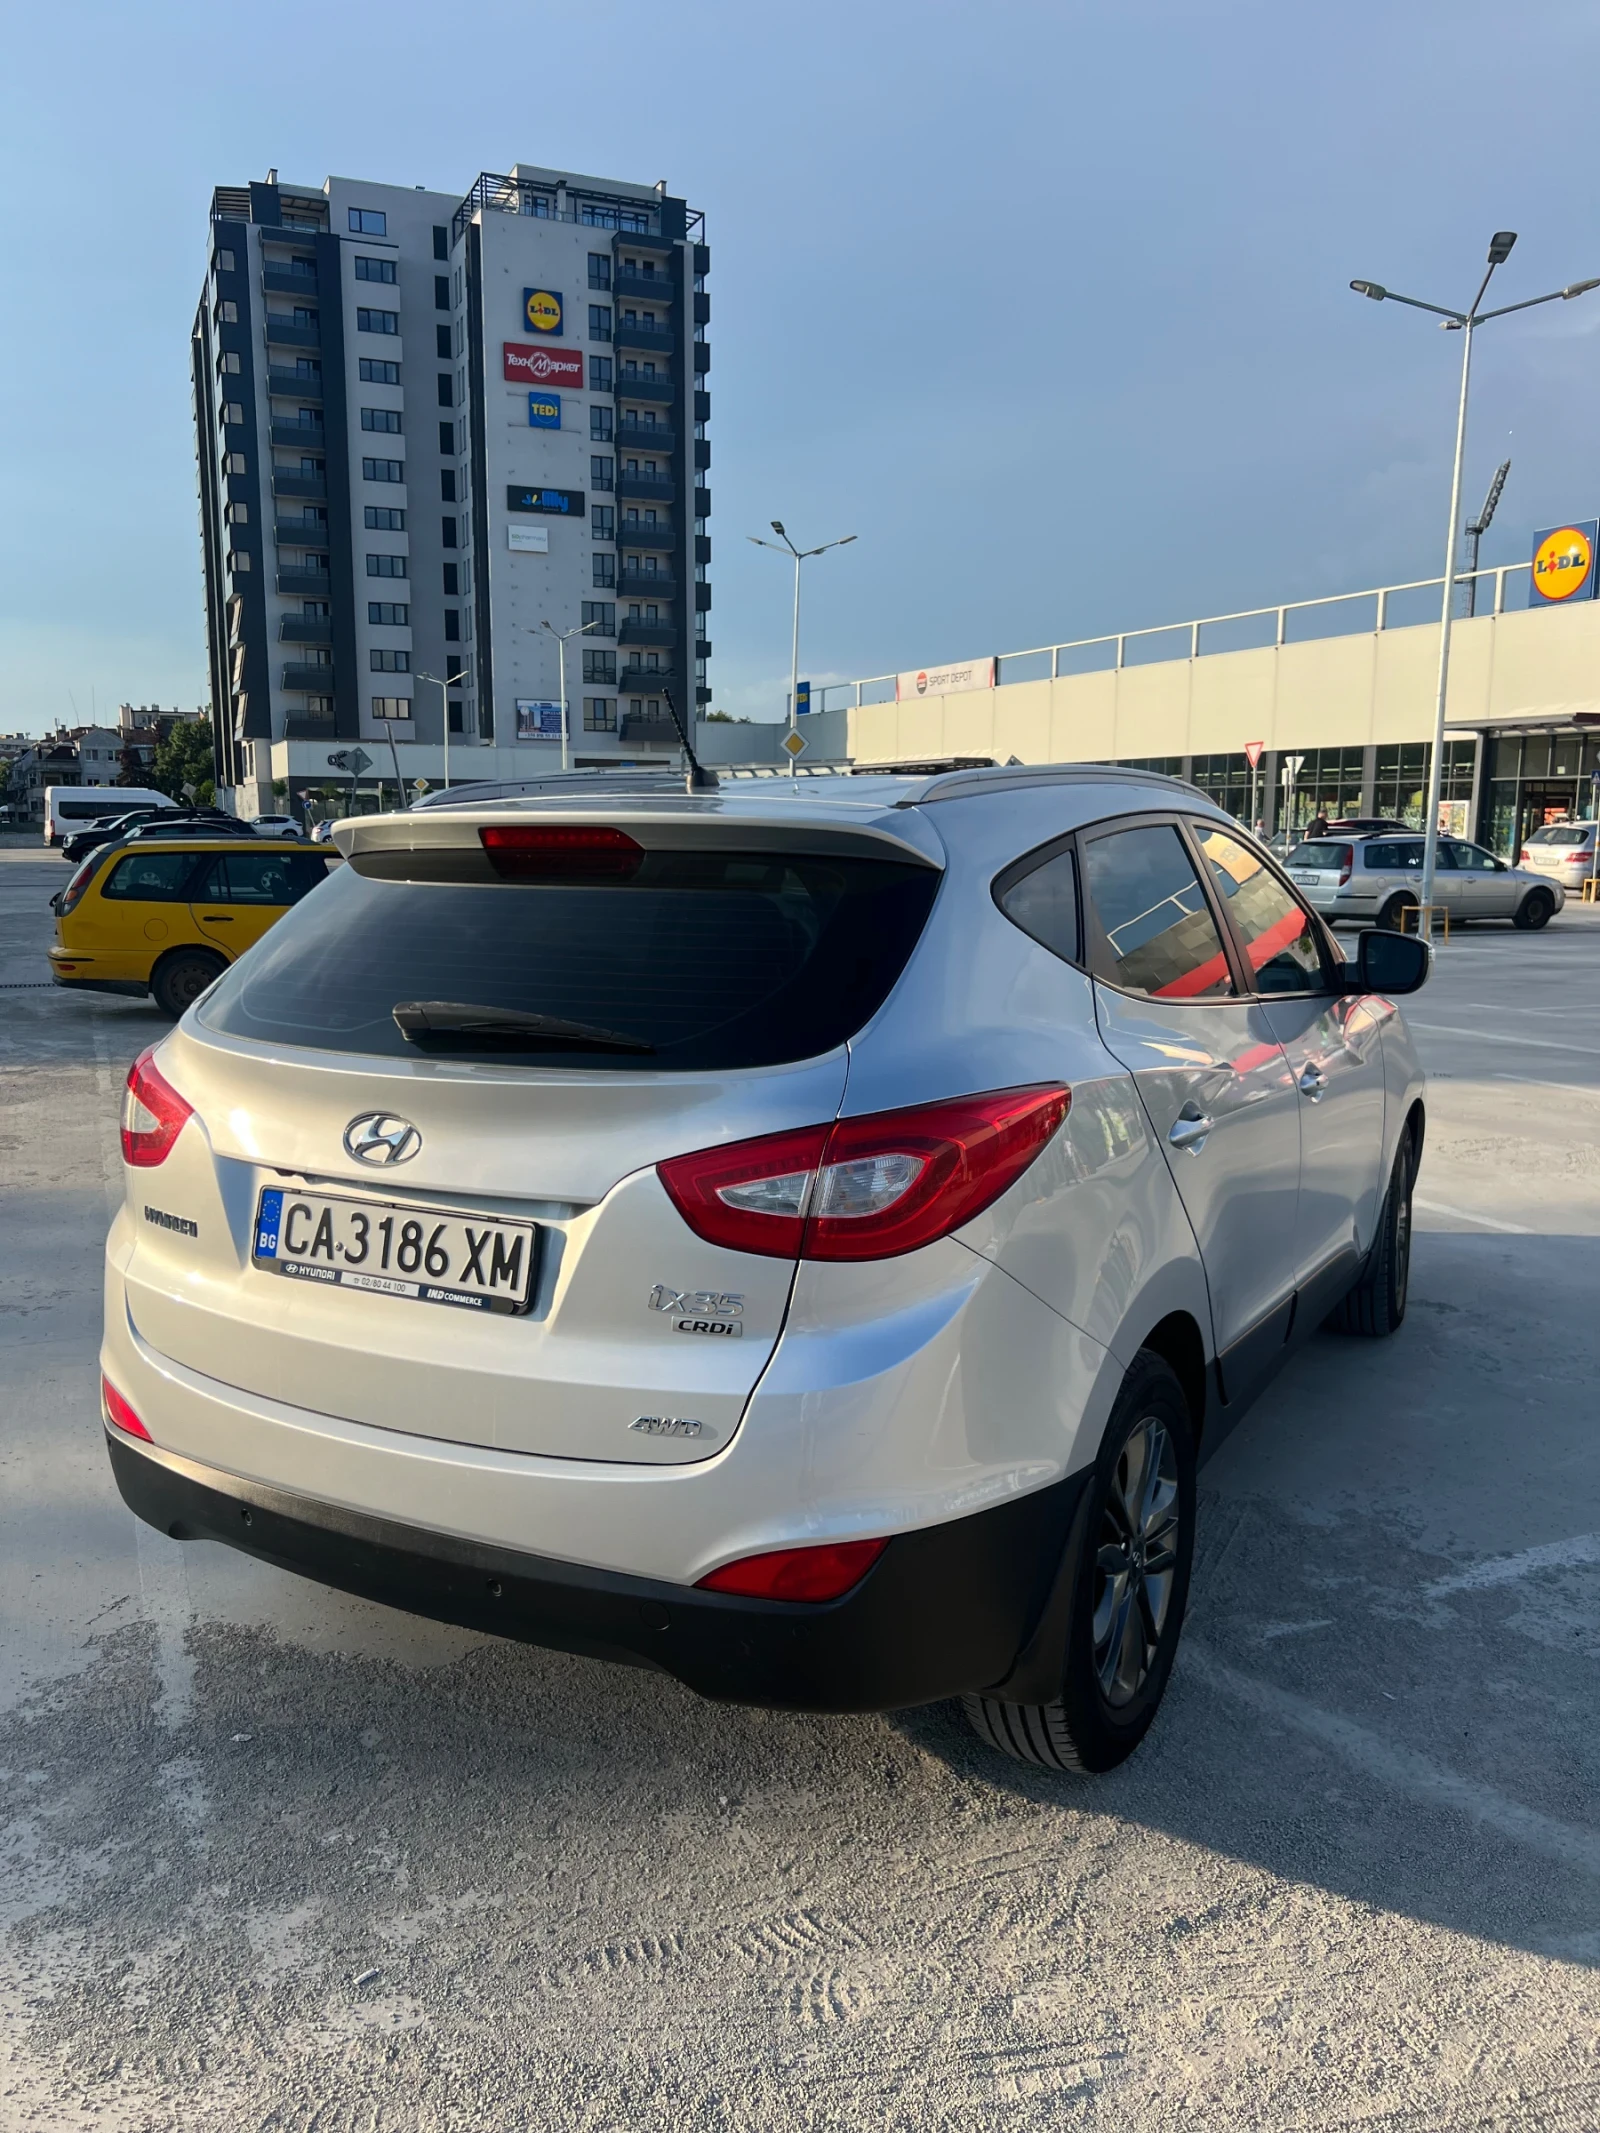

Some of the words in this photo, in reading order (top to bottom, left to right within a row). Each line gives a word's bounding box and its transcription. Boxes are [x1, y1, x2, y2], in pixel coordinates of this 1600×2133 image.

[532, 403, 558, 417] TEDi
[929, 674, 950, 687] SPORT
[951, 670, 972, 683] DEPOT
[259, 1232, 277, 1250] BG
[284, 1202, 335, 1260] CA
[344, 1212, 449, 1278] 3186
[459, 1227, 524, 1292] XM
[299, 1265, 335, 1281] HYUNDAI
[382, 1280, 391, 1290] 44
[393, 1282, 406, 1293] 100
[648, 1283, 745, 1317] ix35
[678, 1320, 734, 1336] CRDi
[628, 1414, 703, 1438] AWD
